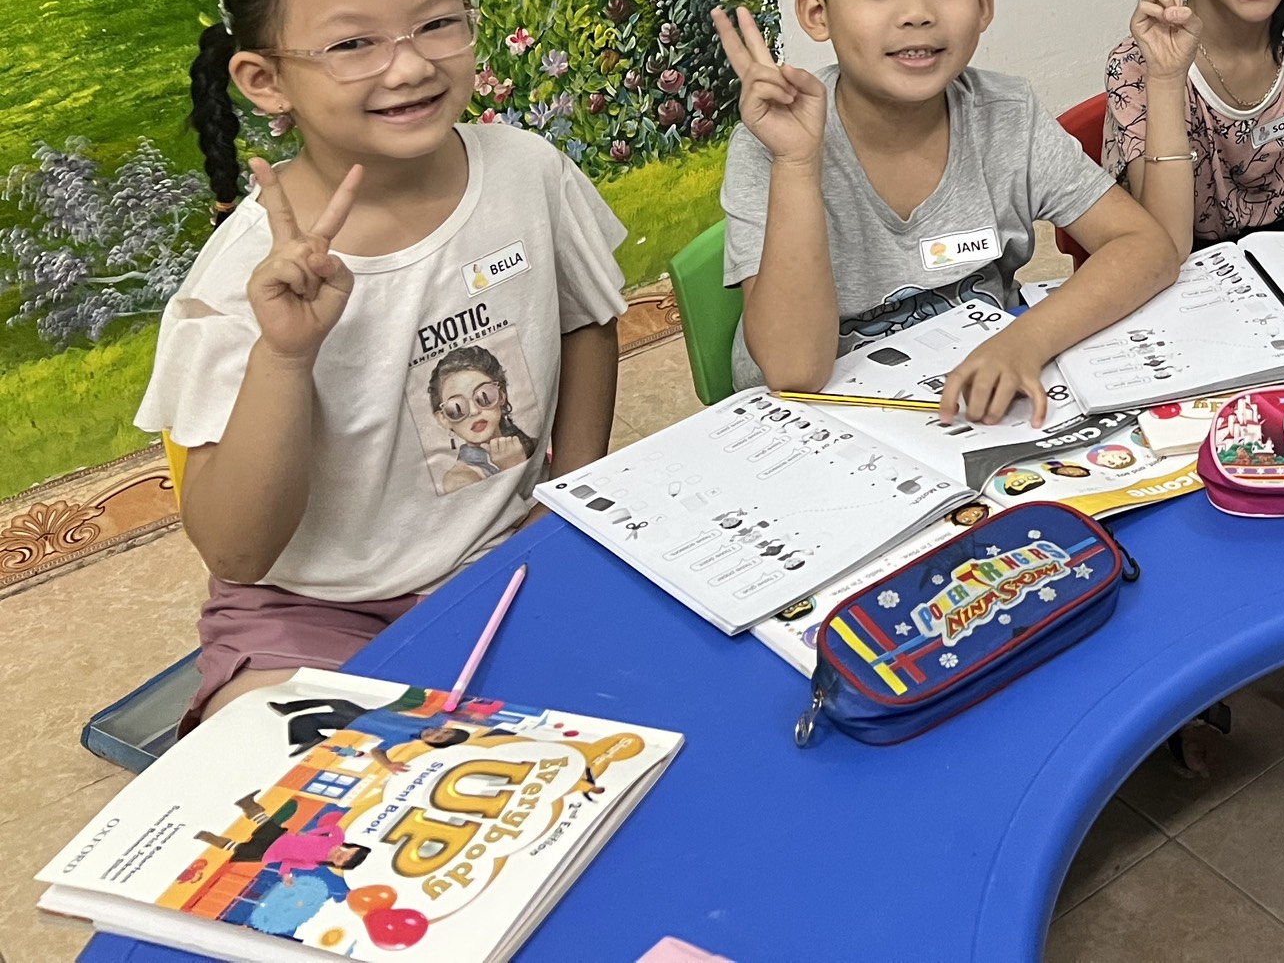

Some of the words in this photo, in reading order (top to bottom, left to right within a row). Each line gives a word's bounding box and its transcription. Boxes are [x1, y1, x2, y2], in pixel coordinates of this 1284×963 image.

[489, 252, 524, 276] BELLA
[956, 238, 990, 254] JANE
[417, 302, 490, 354] EXOTIC
[449, 341, 459, 350] IS
[462, 319, 509, 345] FLEETING
[1035, 427, 1102, 449] Class
[1125, 468, 1204, 498] lcome
[944, 590, 1000, 641] NINJA
[997, 560, 1062, 605] STORM
[398, 761, 444, 802] Student
[362, 804, 399, 835] Book
[379, 758, 537, 878] UP
[421, 756, 569, 901] Everybody
[63, 818, 121, 874] OXFORD
[529, 819, 572, 857] Edition
